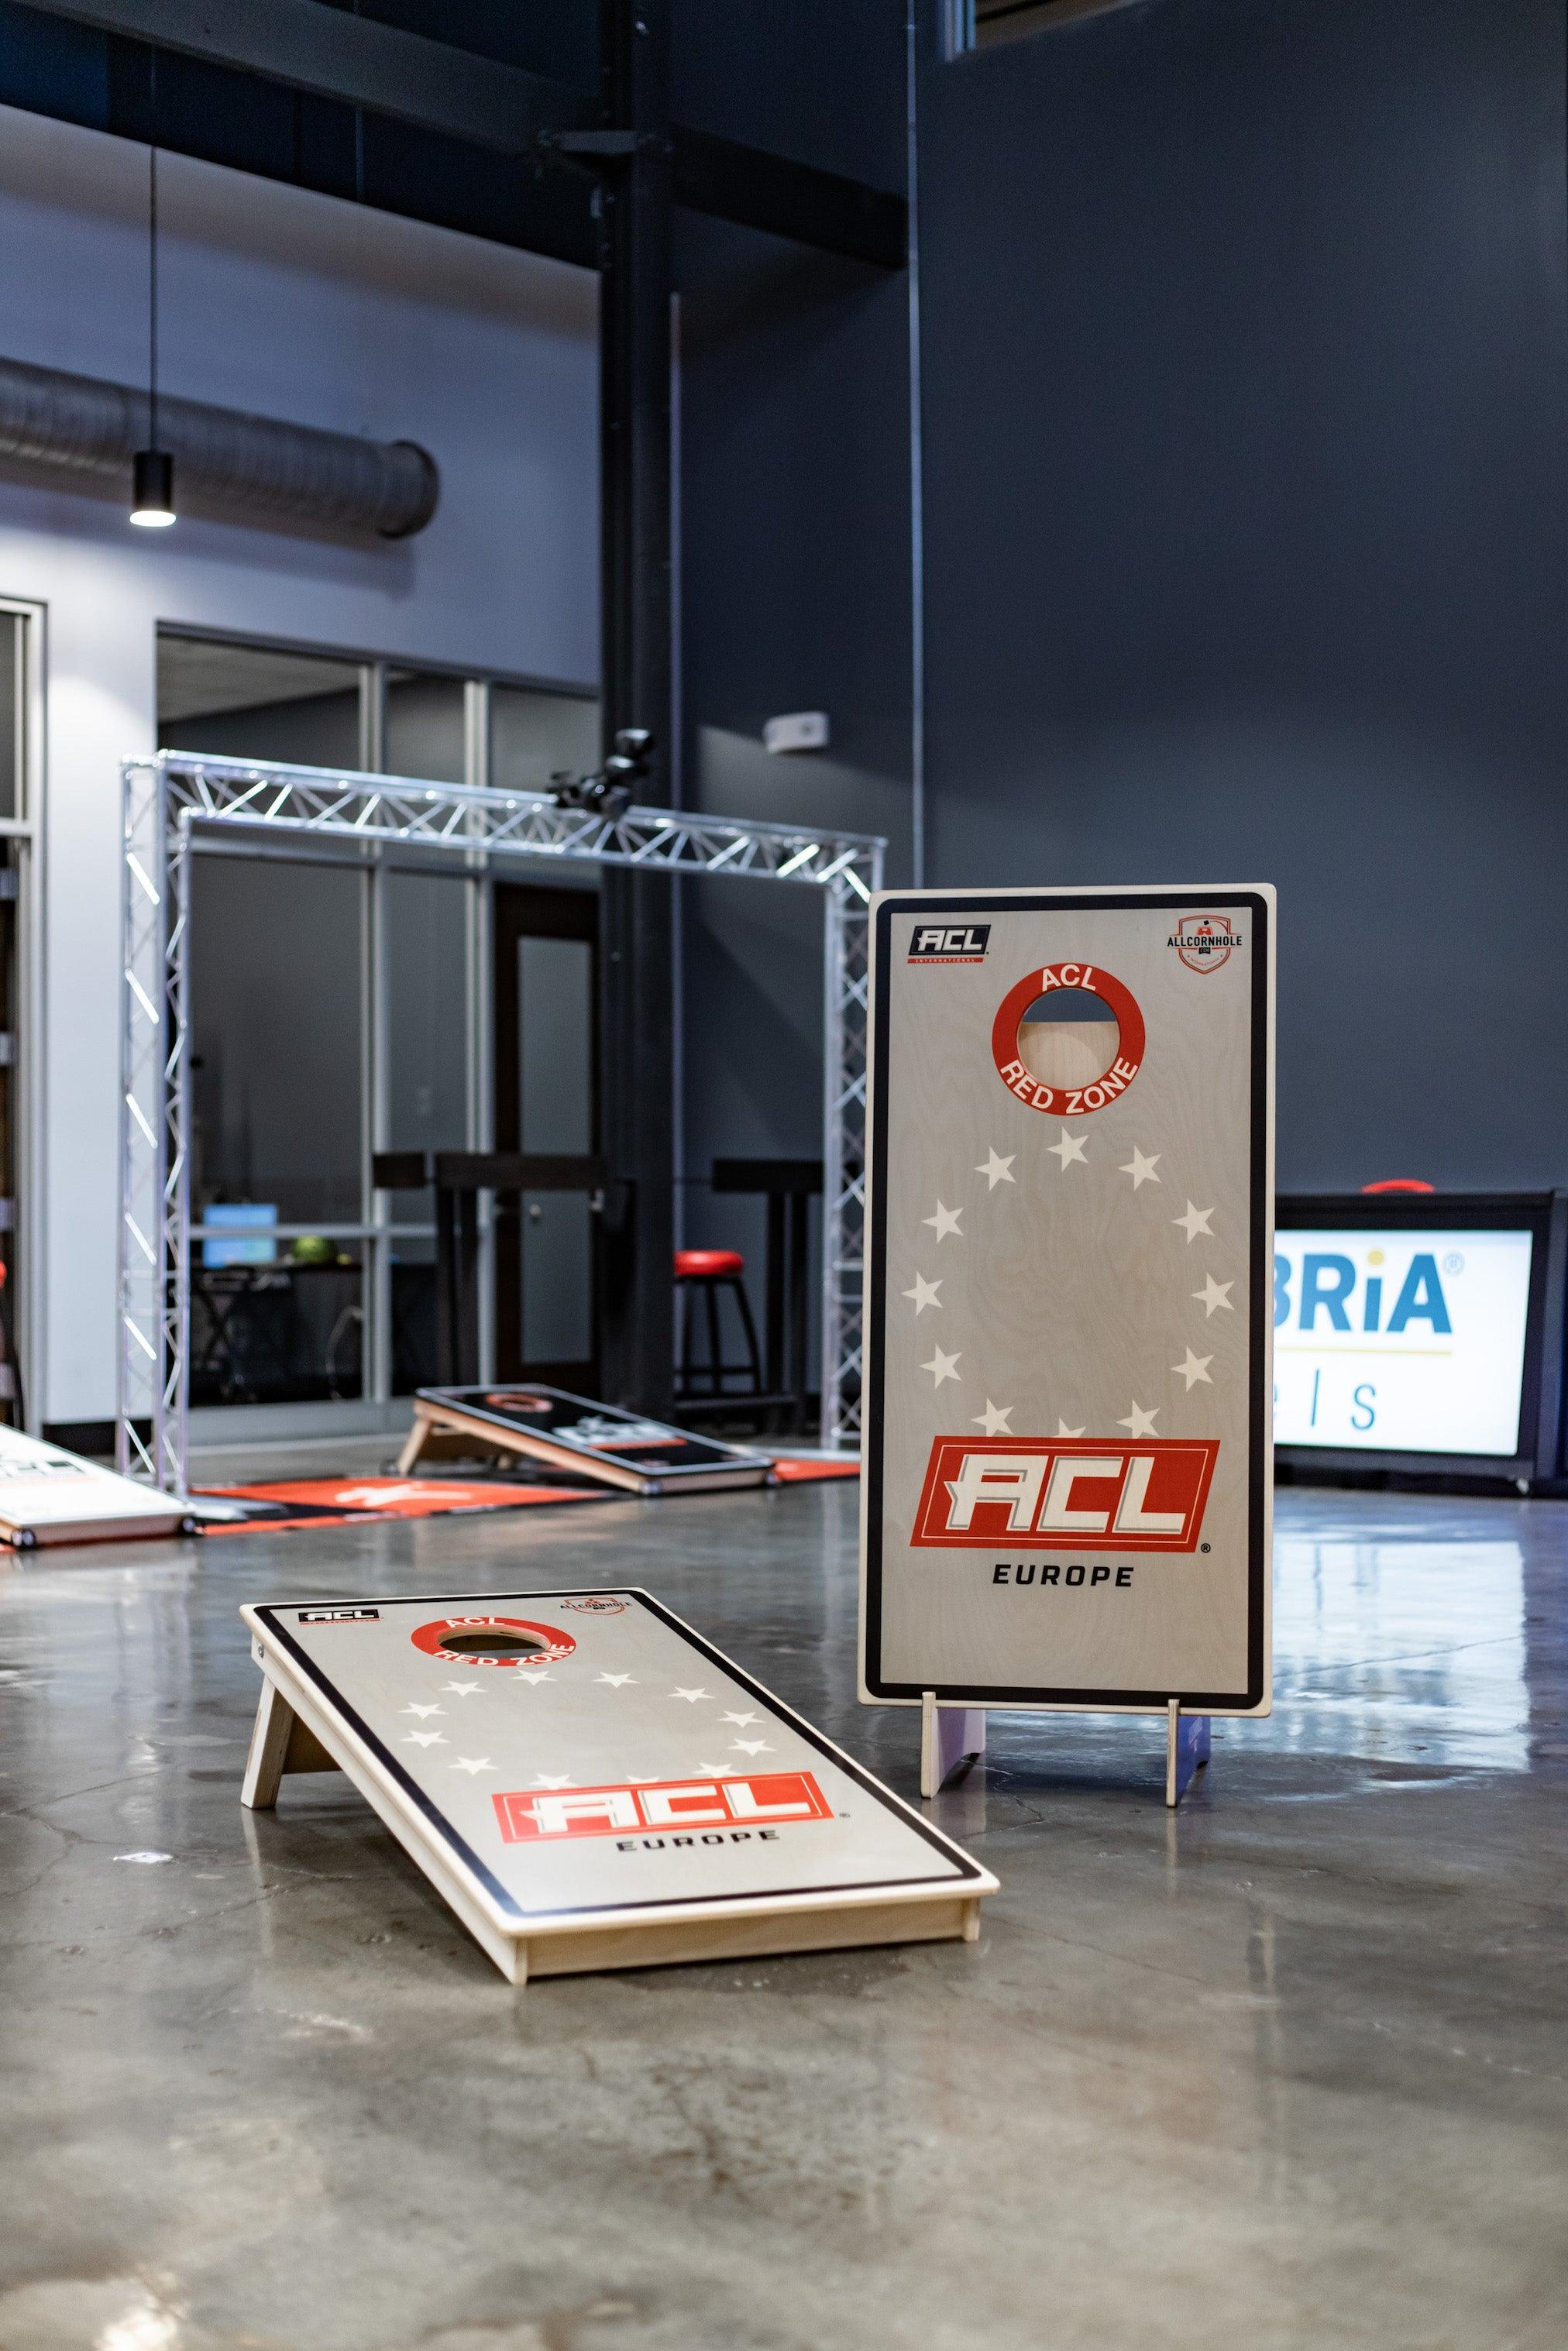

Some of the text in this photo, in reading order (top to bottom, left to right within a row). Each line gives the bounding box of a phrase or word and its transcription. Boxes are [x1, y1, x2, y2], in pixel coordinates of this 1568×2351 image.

[917, 929, 982, 951] ACL
[1167, 935, 1243, 947] ALLCORNHOLE
[1040, 964, 1097, 992] ACL
[999, 1057, 1139, 1115] RED ZONE
[943, 1453, 1187, 1535] ACL
[992, 1563, 1135, 1588] EUROPE
[305, 1610, 375, 1621] ACL
[445, 1617, 505, 1628] ACL
[433, 1643, 576, 1666] RED ZONE
[519, 1782, 812, 1834] ACL
[615, 1829, 781, 1852] EUROPE
